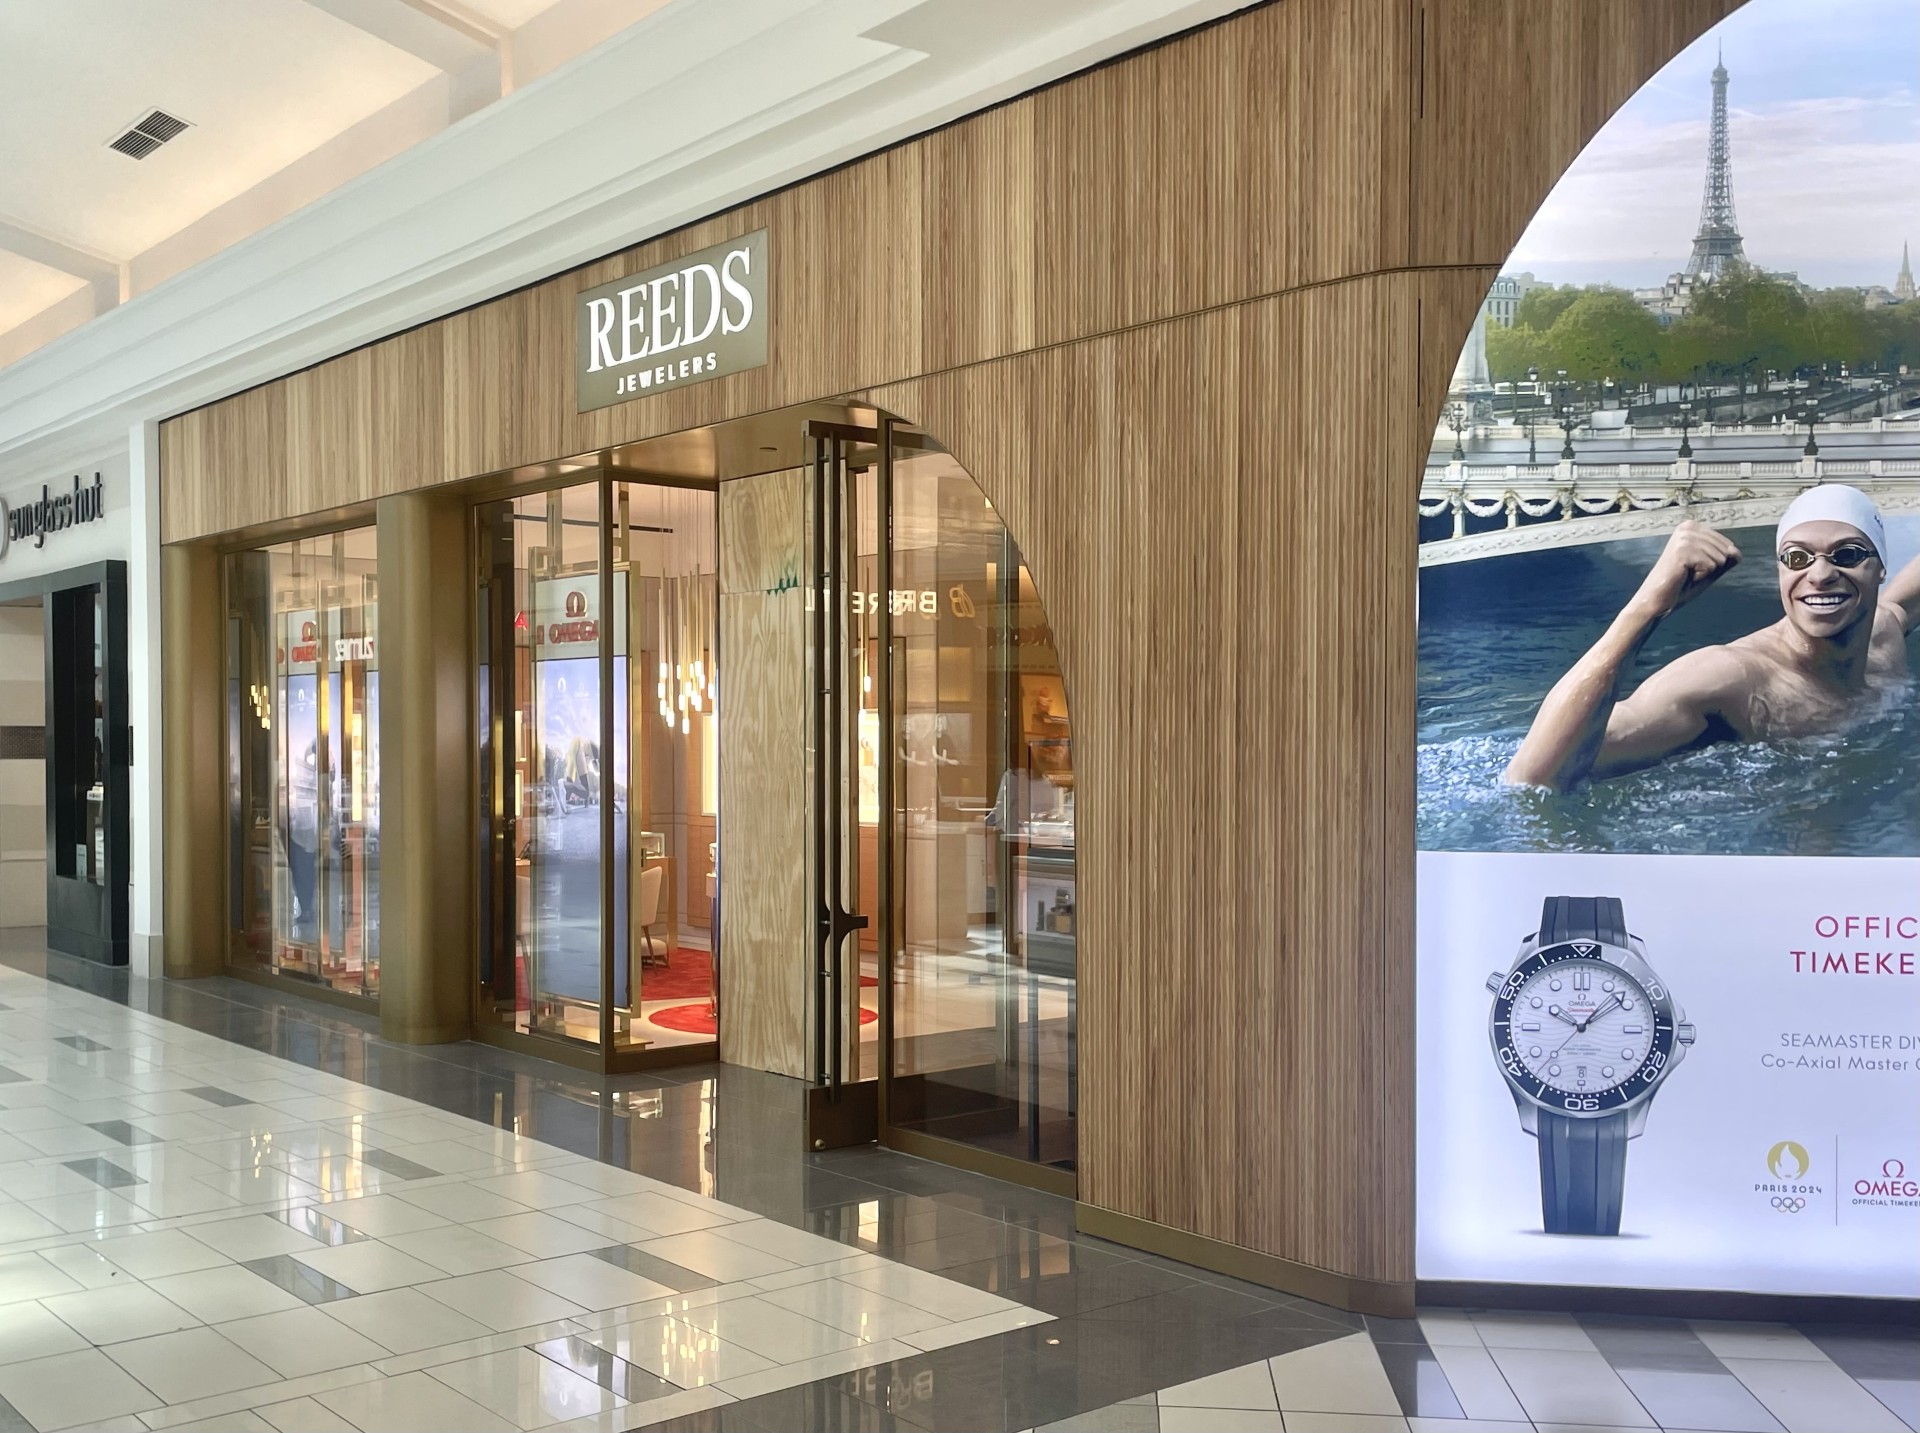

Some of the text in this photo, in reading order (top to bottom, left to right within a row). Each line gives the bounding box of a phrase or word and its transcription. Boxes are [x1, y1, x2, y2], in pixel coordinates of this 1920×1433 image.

[585, 246, 754, 373] REEDS
[616, 352, 717, 395] JEWELERS
[1815, 915, 1919, 939] OFFIC
[1790, 951, 1915, 975] TIMEKE
[1500, 971, 1525, 1001] 50
[1646, 977, 1665, 1002] 10
[1781, 1033, 1920, 1050] SEAMASTER DI
[1499, 1047, 1522, 1077] 40
[1642, 1051, 1666, 1083] 20
[1761, 1053, 1841, 1069] Co-Axial
[1848, 1056, 1908, 1071] Master
[1564, 1097, 1600, 1111] 30
[1754, 1184, 1822, 1194] PARIS 2024
[1855, 1179, 1920, 1197] OMEG
[1852, 1198, 1888, 1206] OFFICIAL
